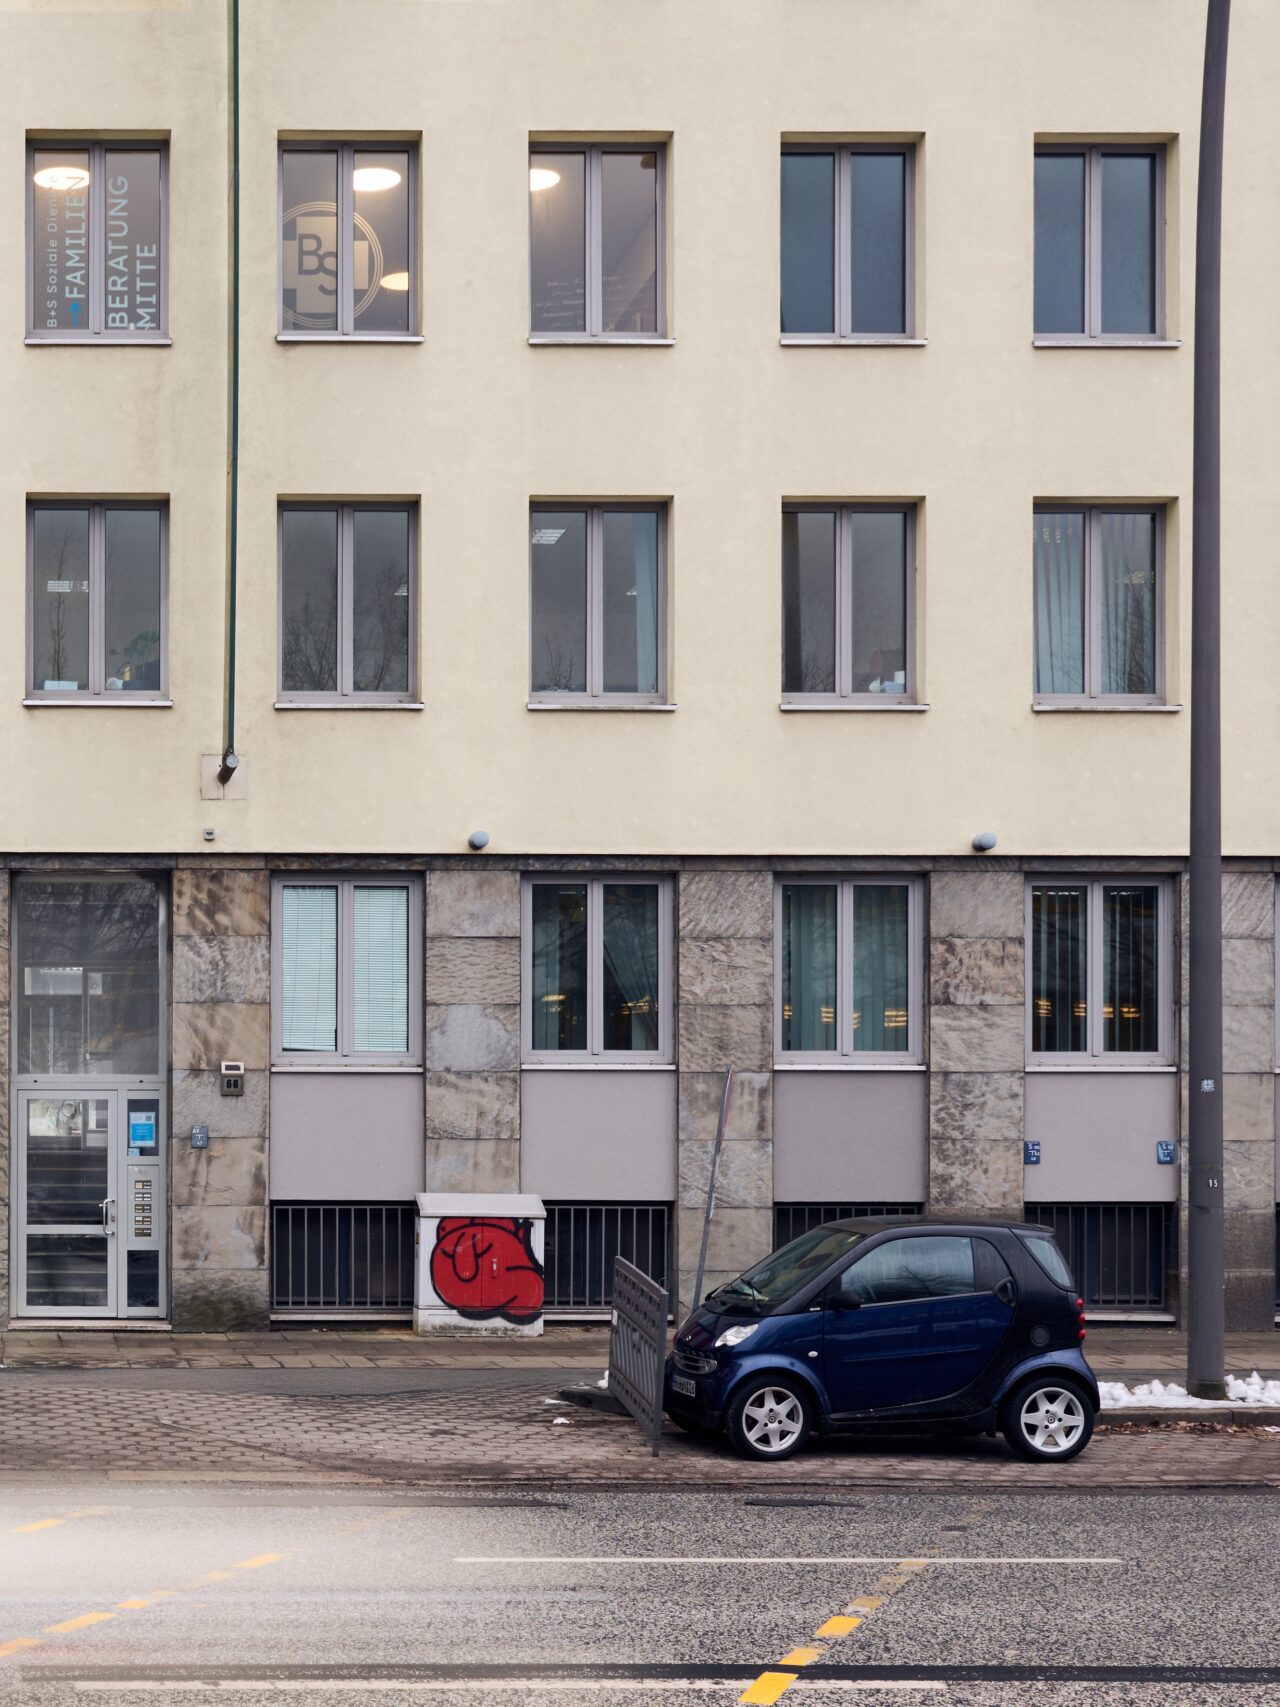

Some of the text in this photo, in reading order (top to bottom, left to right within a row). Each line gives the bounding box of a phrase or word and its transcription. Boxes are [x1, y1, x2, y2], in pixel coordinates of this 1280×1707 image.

[65, 176, 86, 299] FAMILIEN
[107, 175, 129, 328] BERATUNG
[46, 239, 58, 293] Soziale
[135, 243, 157, 328] MITTE
[47, 300, 58, 328] B+S
[226, 1079, 239, 1089] 68
[1208, 1179, 1219, 1188] 15
